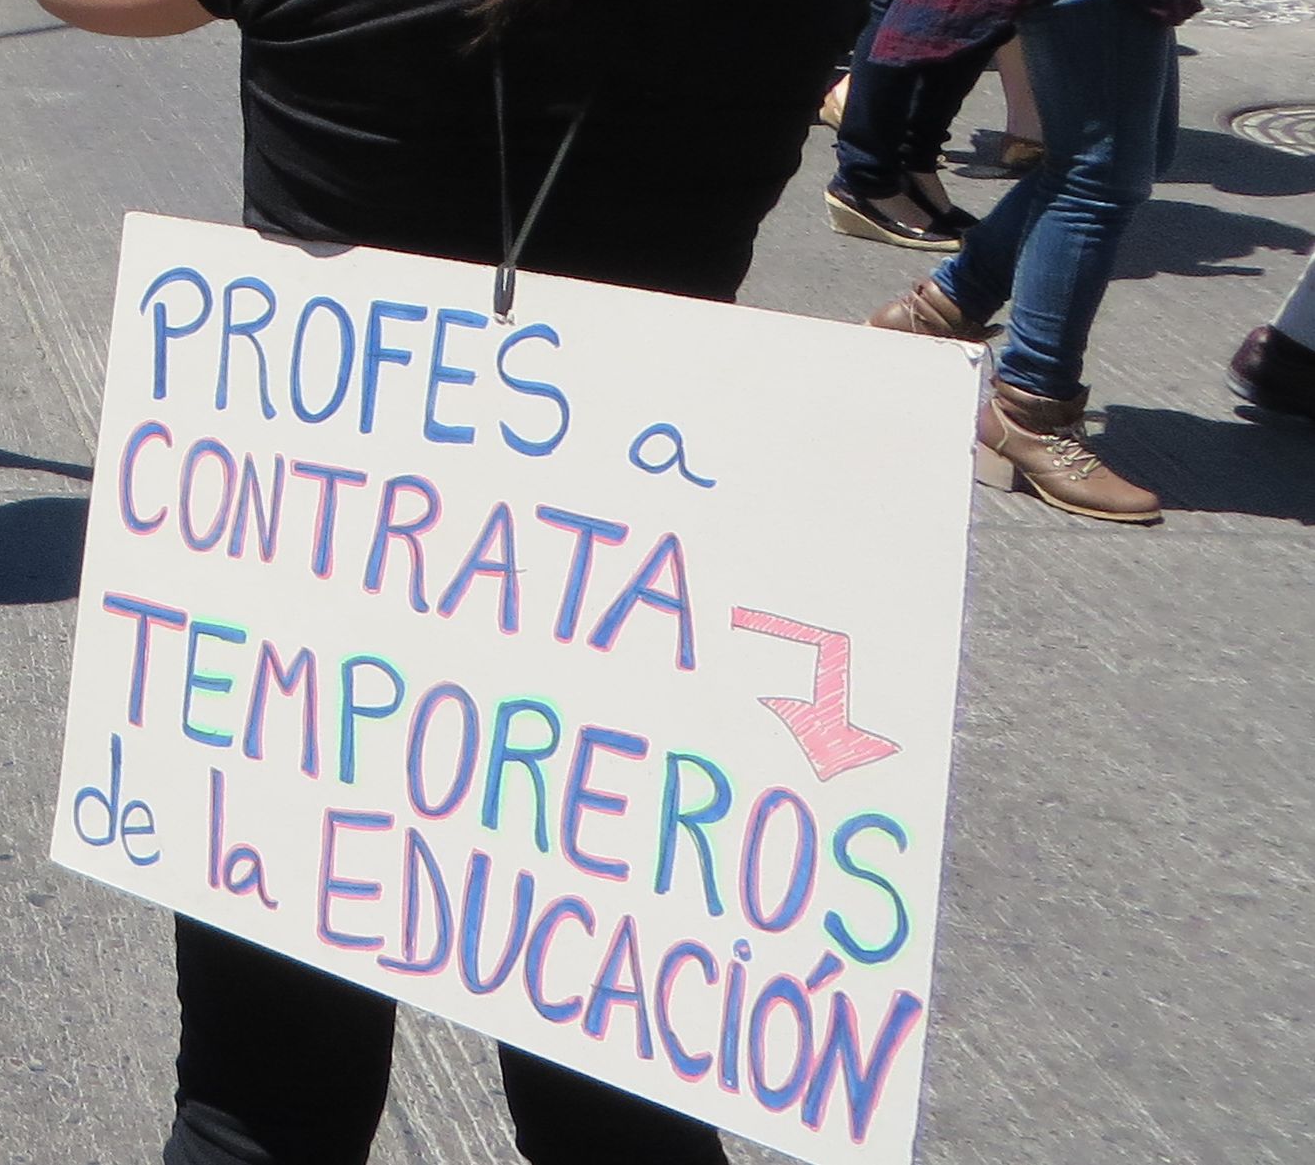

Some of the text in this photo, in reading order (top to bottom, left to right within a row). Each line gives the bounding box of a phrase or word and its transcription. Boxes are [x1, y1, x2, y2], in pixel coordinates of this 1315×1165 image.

[141, 266, 717, 488] PROFES a
[119, 420, 697, 671] CONTRATA
[73, 733, 162, 867] de
[208, 767, 279, 911] la
[103, 592, 911, 966] TEMPOREROS
